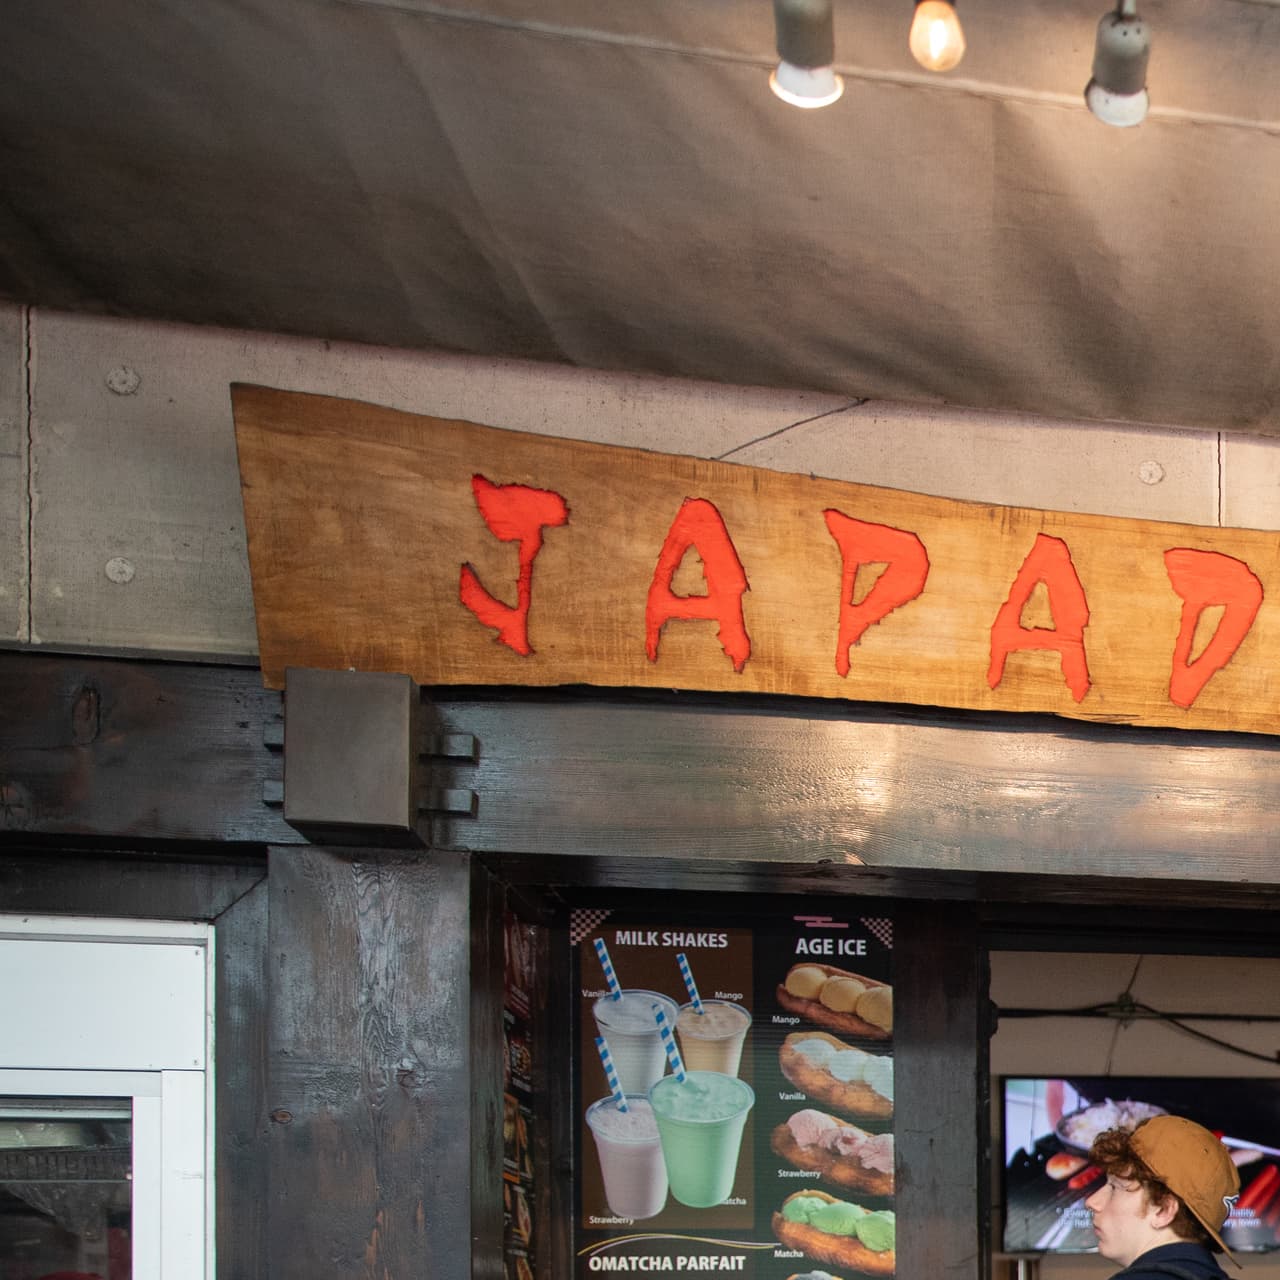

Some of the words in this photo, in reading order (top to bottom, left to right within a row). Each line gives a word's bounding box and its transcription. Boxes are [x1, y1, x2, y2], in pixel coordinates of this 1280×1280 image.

[615, 930, 658, 947] MILK
[662, 931, 728, 948] SHAKES
[795, 938, 835, 956] AGE
[838, 938, 867, 956] ICE
[715, 991, 743, 1001] Mango
[772, 1015, 800, 1026] Mango
[779, 1092, 806, 1101] Vanilla
[778, 1169, 821, 1180] Strawberry
[720, 1196, 747, 1206] atcha
[589, 1215, 634, 1226] Strawberry
[774, 1249, 804, 1258] Matcha
[589, 1256, 673, 1271] OMATCHA
[677, 1255, 746, 1271] PARFAIT
